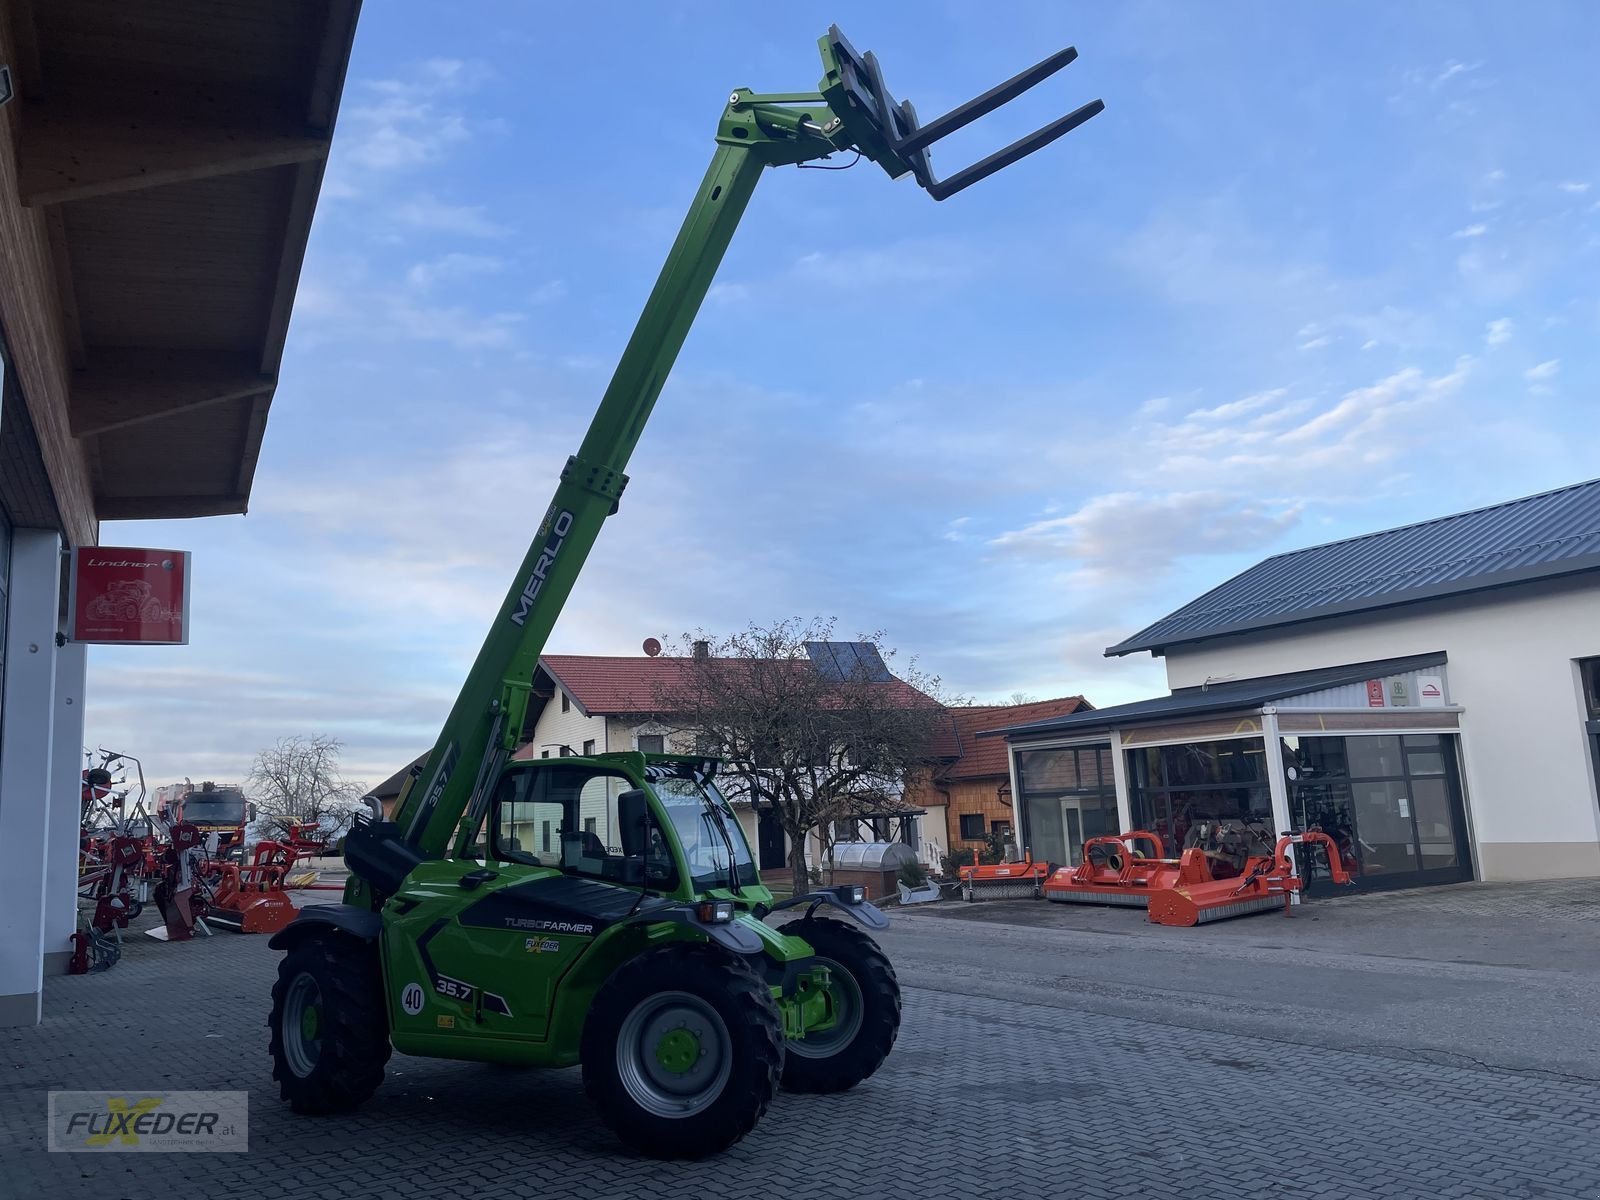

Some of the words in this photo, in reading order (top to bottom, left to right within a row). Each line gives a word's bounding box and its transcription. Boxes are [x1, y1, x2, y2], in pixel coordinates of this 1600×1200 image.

[88, 558, 158, 568] Lindner
[511, 511, 574, 626] MERLO
[429, 771, 448, 807] 35.7
[504, 917, 593, 934] TURBOFARMER
[405, 988, 421, 1010] 40
[436, 979, 472, 1000] 35.7
